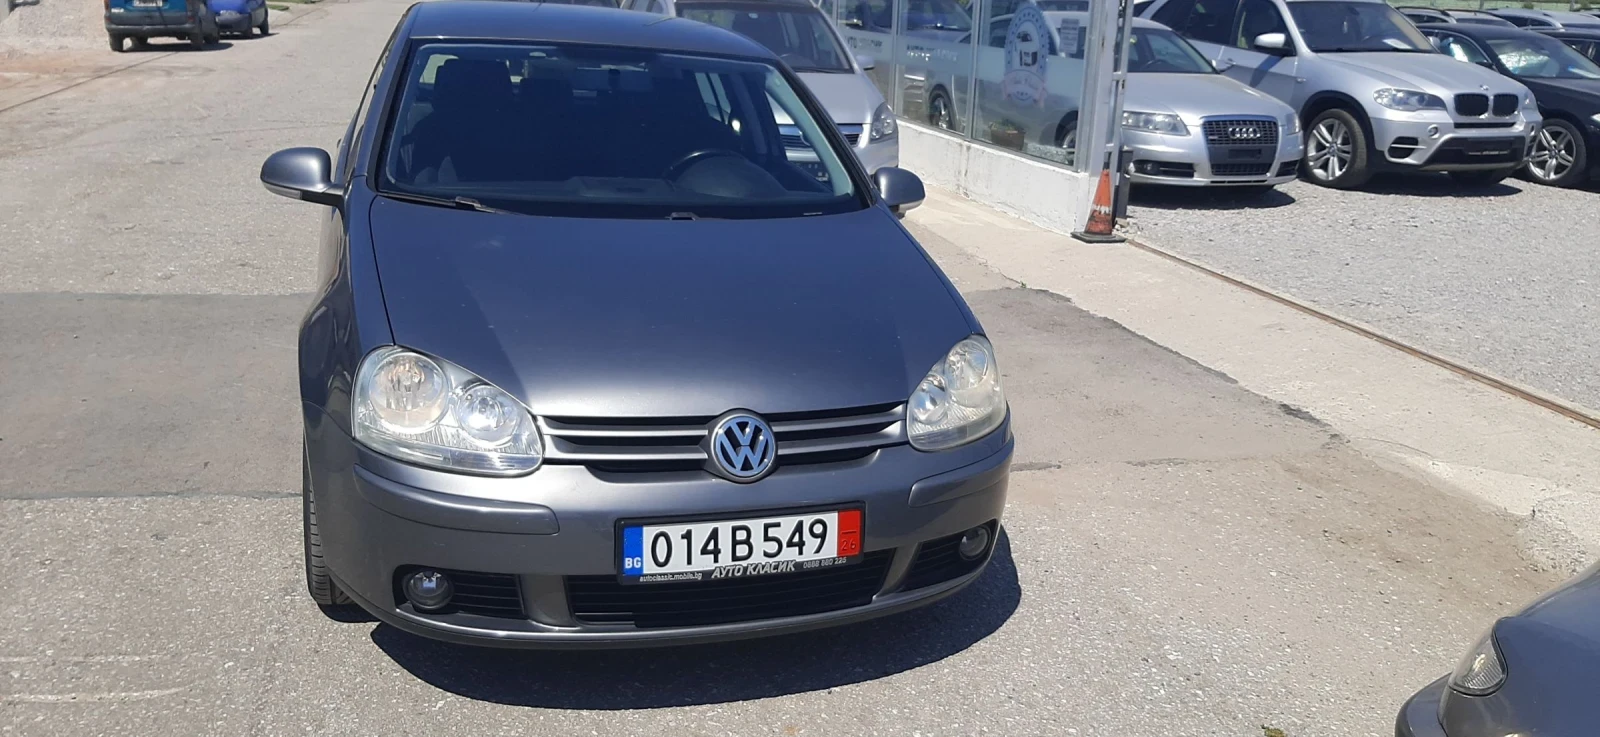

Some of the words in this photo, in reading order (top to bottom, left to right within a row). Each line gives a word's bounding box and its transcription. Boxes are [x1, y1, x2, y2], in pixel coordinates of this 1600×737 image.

[715, 416, 773, 476] VW
[624, 557, 642, 569] BG
[711, 565, 743, 578] АУТО
[746, 560, 796, 575] КЛАСИК
